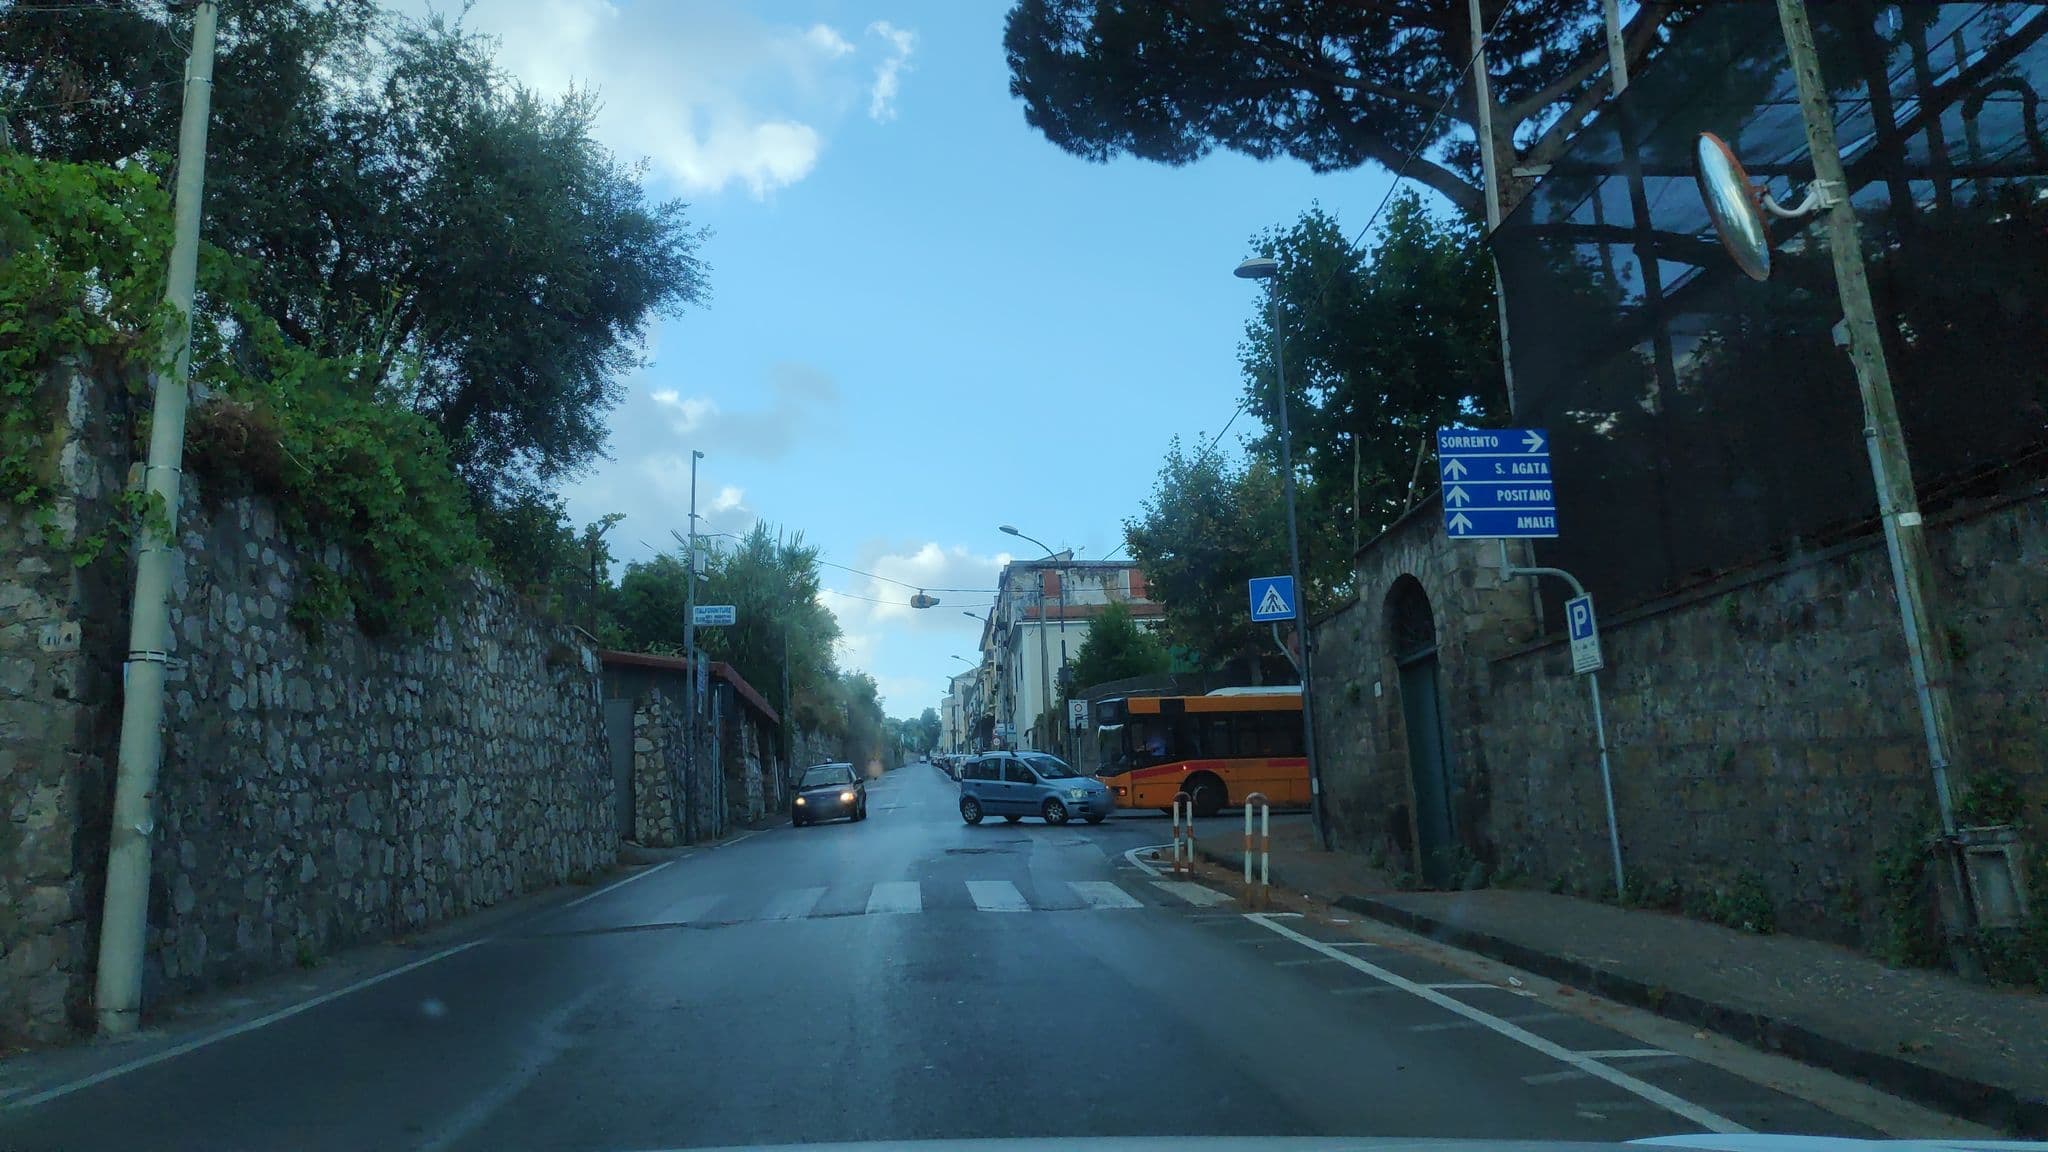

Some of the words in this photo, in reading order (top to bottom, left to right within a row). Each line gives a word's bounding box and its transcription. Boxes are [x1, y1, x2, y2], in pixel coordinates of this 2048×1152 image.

[1441, 436, 1498, 448] SORRENTO
[1495, 463, 1505, 474] S.
[1512, 463, 1548, 474] AGATA
[1497, 490, 1551, 501] POSITANO
[1517, 517, 1554, 528] AMALFI
[1573, 605, 1587, 636] P
